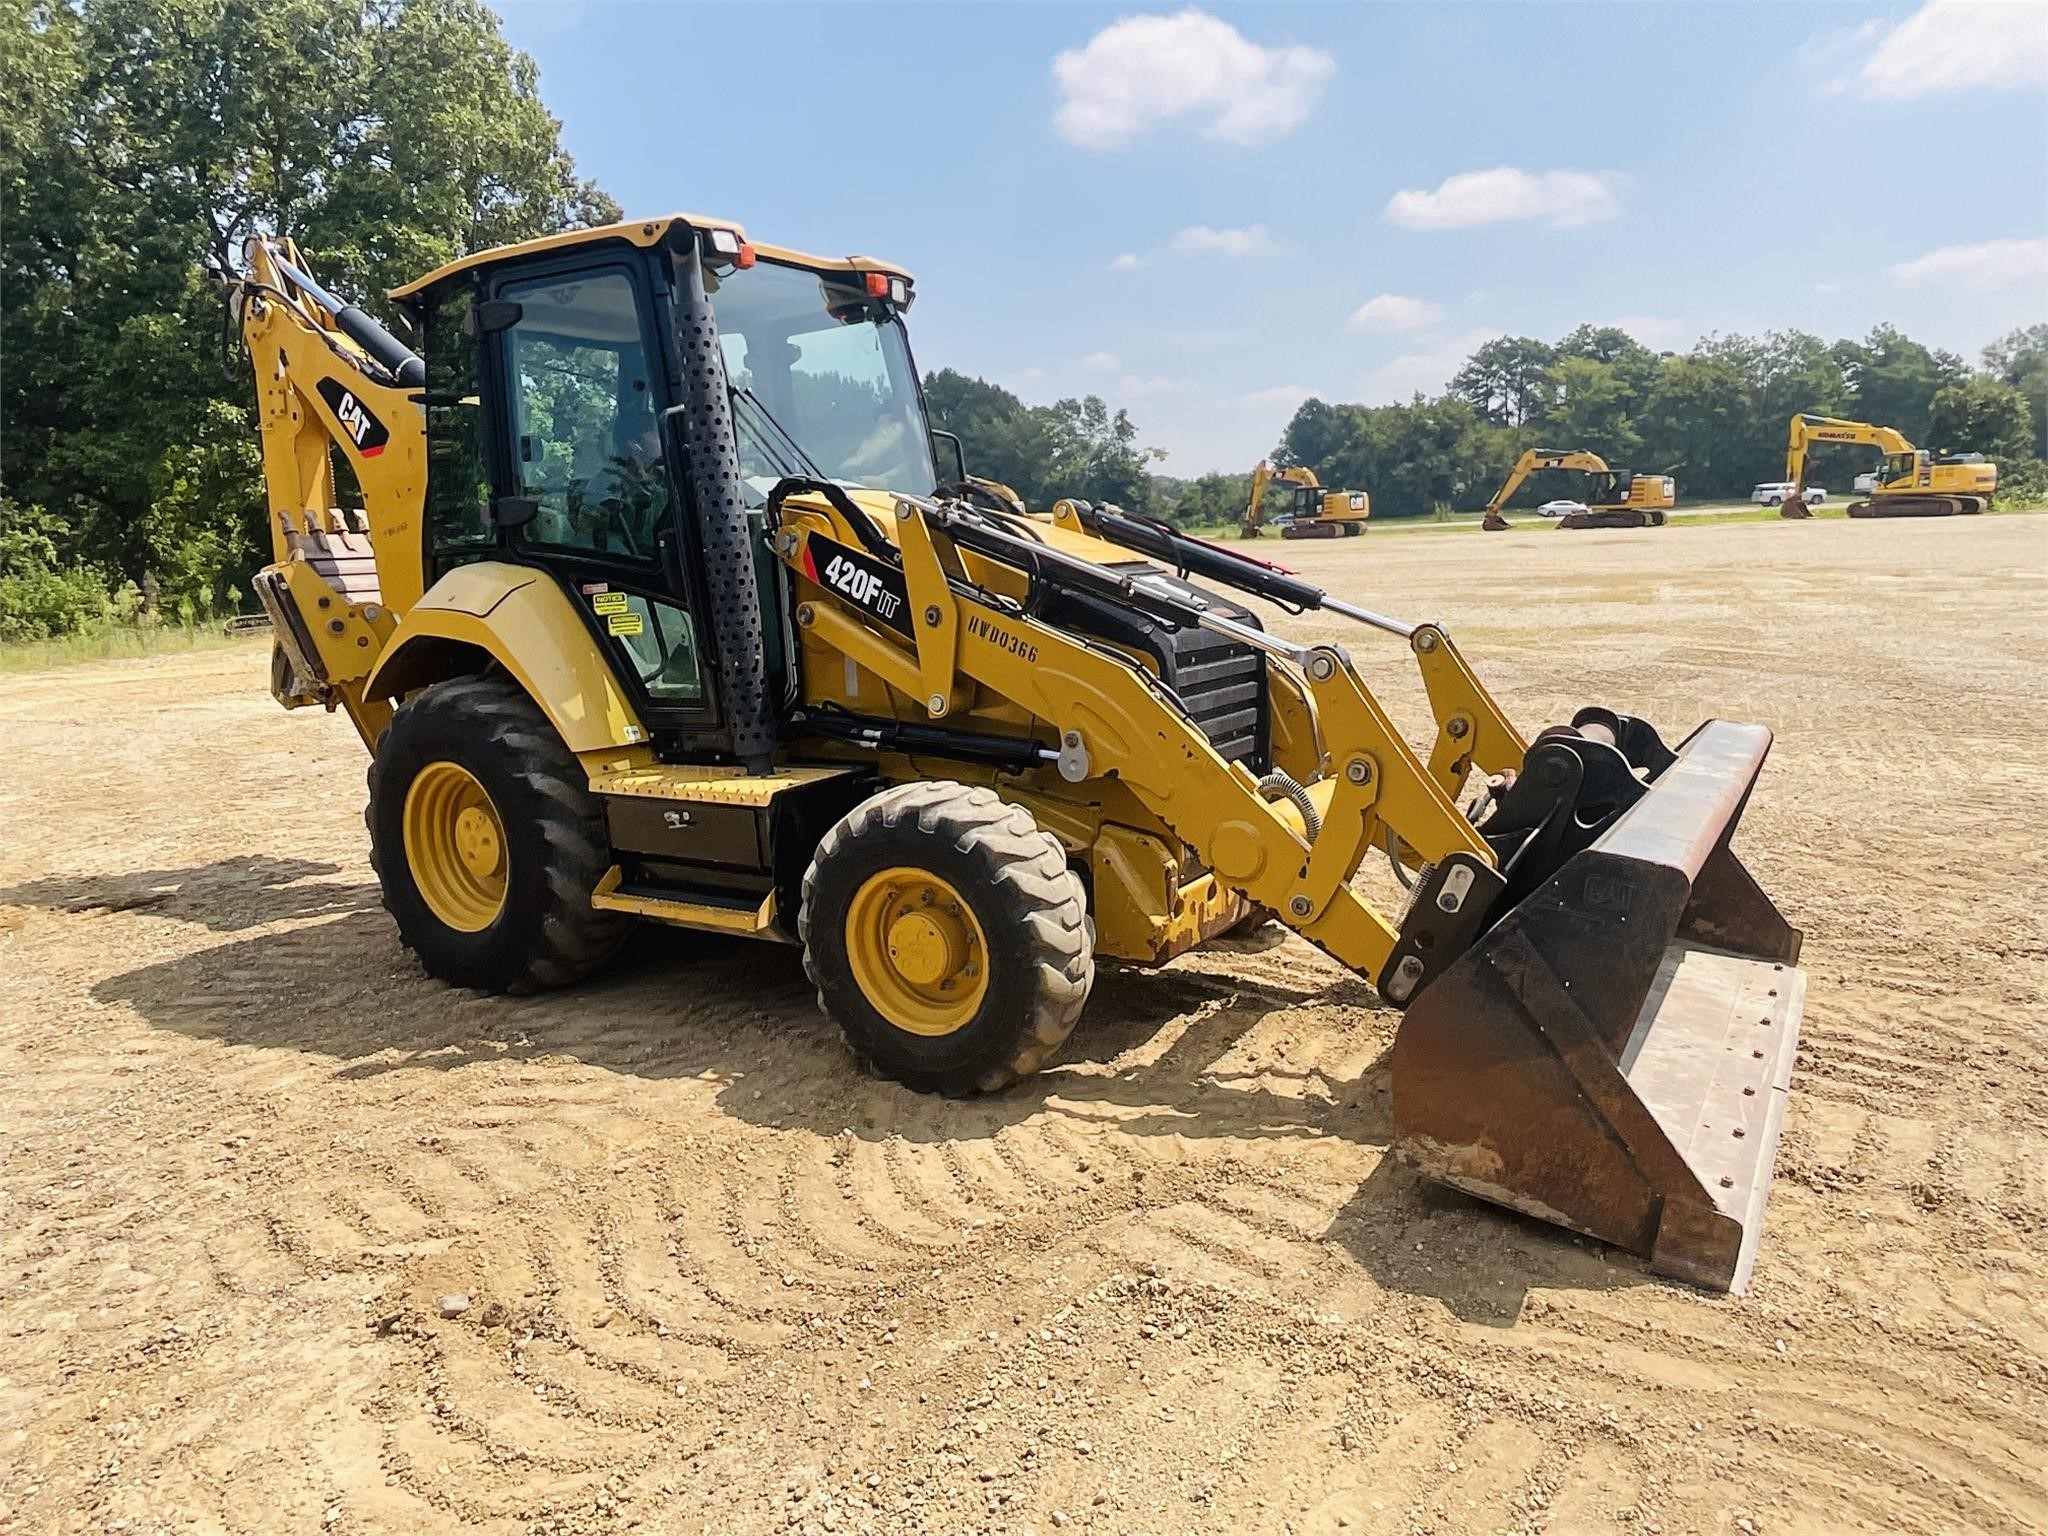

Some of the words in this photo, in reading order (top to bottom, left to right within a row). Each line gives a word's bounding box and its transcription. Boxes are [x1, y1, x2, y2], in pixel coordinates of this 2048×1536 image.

[338, 391, 371, 445] CAT
[1817, 431, 1856, 439] KOMATSU
[825, 555, 883, 605] 420F
[876, 589, 901, 619] IT
